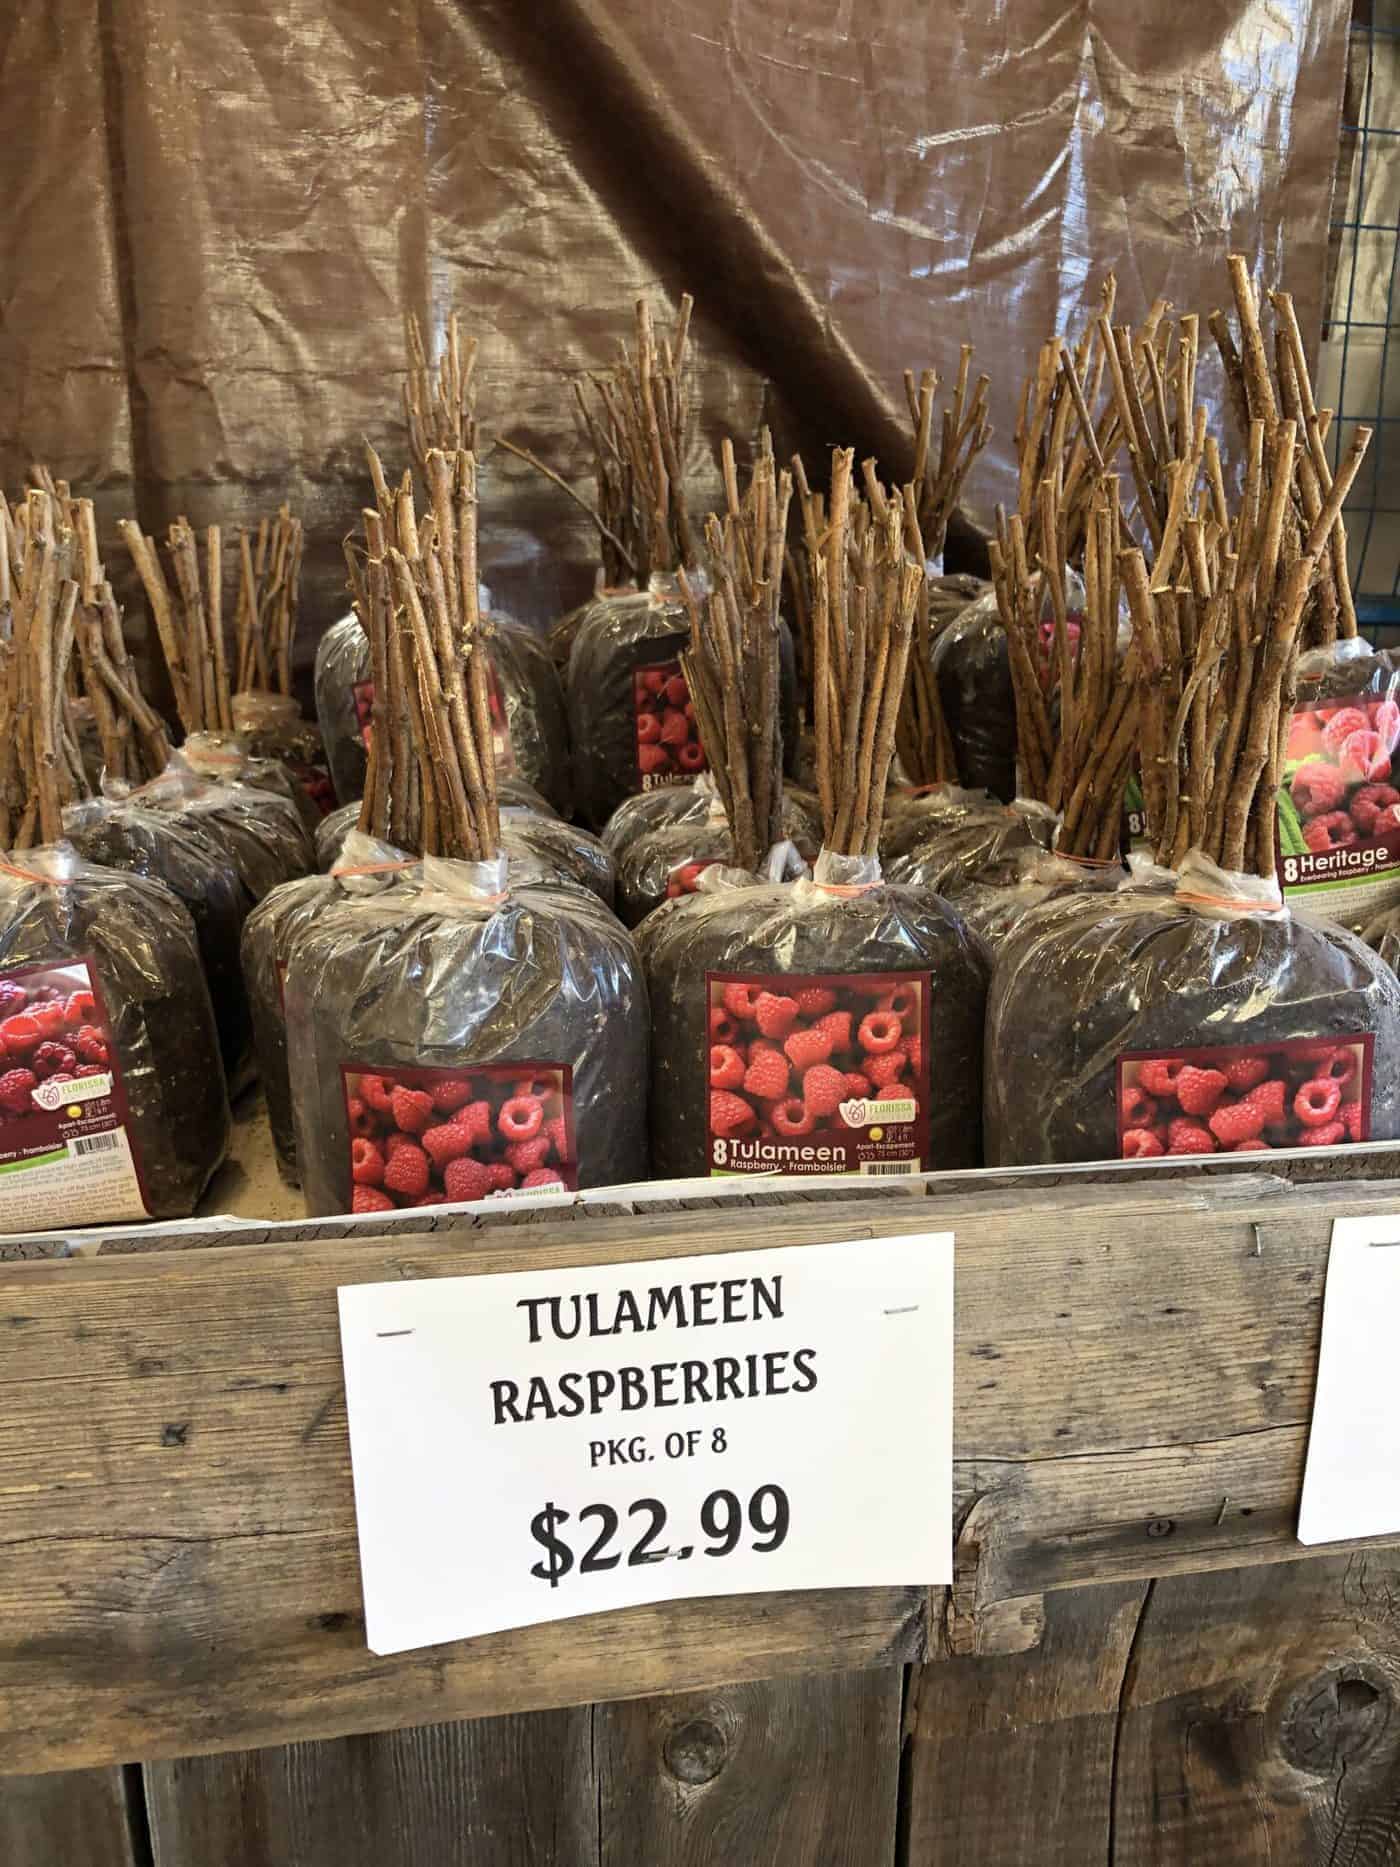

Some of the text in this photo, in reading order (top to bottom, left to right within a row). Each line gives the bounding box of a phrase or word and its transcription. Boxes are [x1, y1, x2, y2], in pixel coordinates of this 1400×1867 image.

[1128, 813, 1141, 833] 8
[1283, 847, 1388, 882] 8 Heritage
[713, 1139, 846, 1165] 8 Tulameen
[730, 1160, 780, 1171] Raspberry
[516, 1275, 785, 1343] TULAMEEN
[488, 1347, 819, 1425] RASPBERRIES
[588, 1427, 728, 1467] PKG. OF 8
[529, 1483, 791, 1589] $22.99
